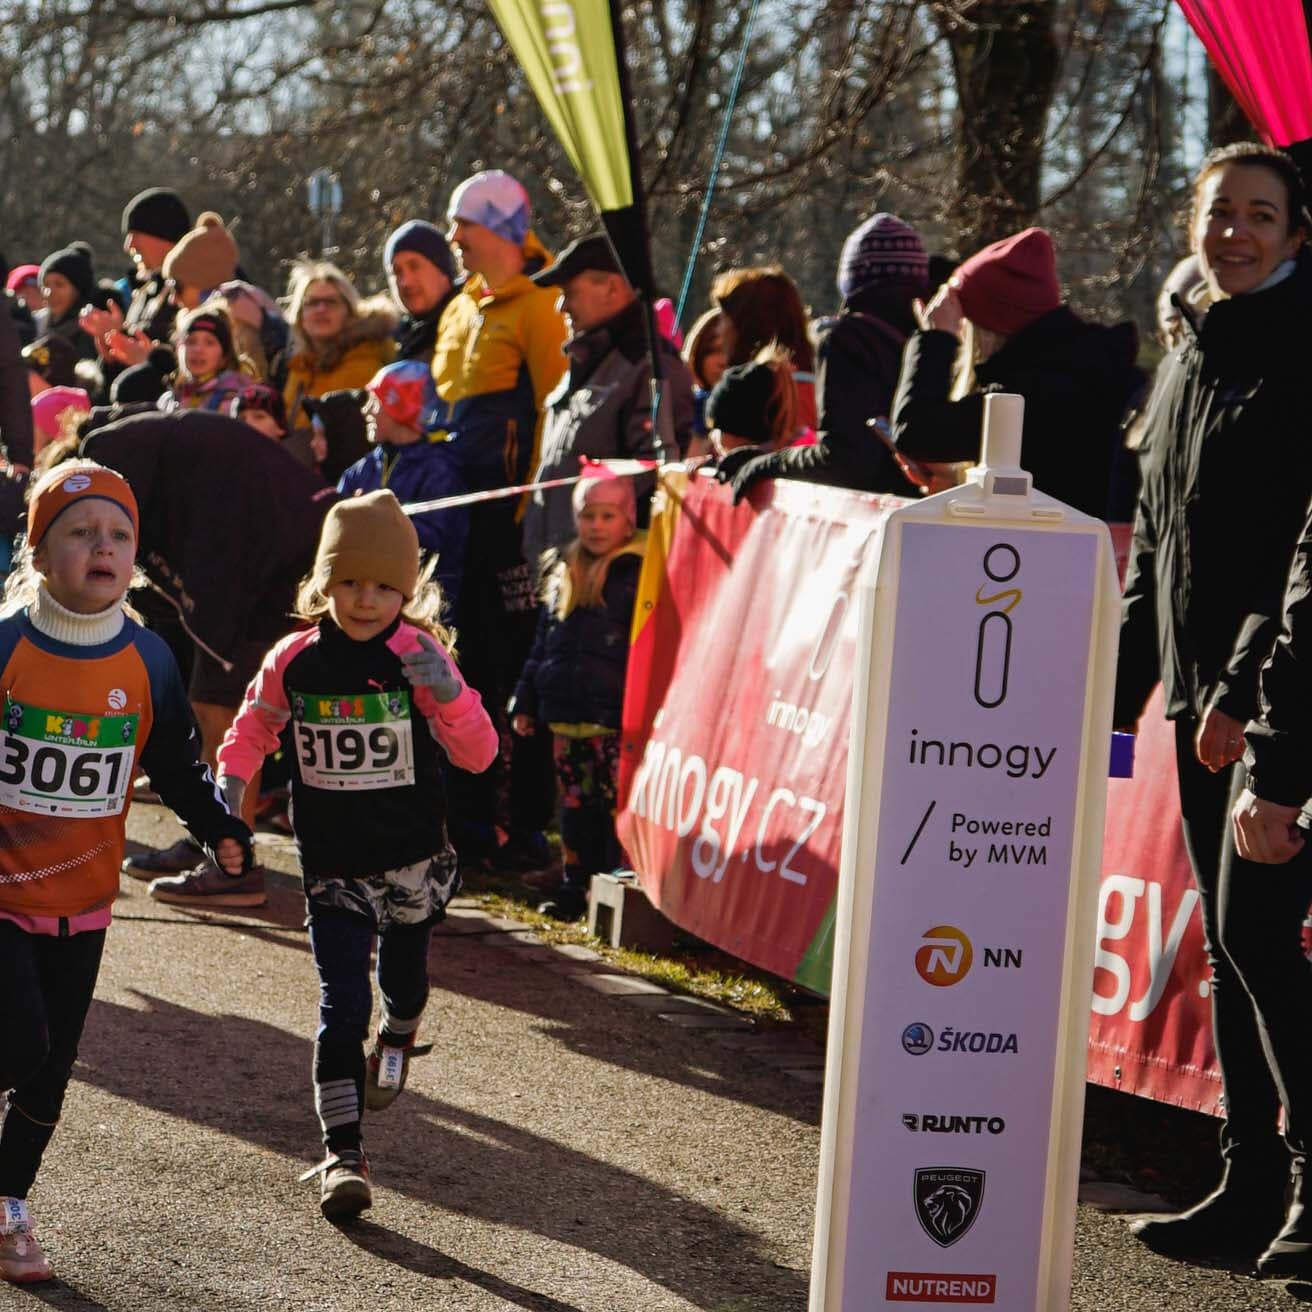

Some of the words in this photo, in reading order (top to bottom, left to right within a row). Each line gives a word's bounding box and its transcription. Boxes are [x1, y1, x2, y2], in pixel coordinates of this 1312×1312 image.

[298, 727, 399, 770] 3199
[908, 729, 1057, 778] innogy
[951, 813, 1052, 838] Powered
[948, 841, 977, 868] by
[987, 843, 1048, 866] MVM
[982, 947, 1023, 969] NN
[937, 1027, 1019, 1054] ŠKODA
[921, 1115, 1005, 1135] RUNTO
[921, 1174, 979, 1184] PEUGEOT
[893, 1278, 991, 1297] NUTREND
